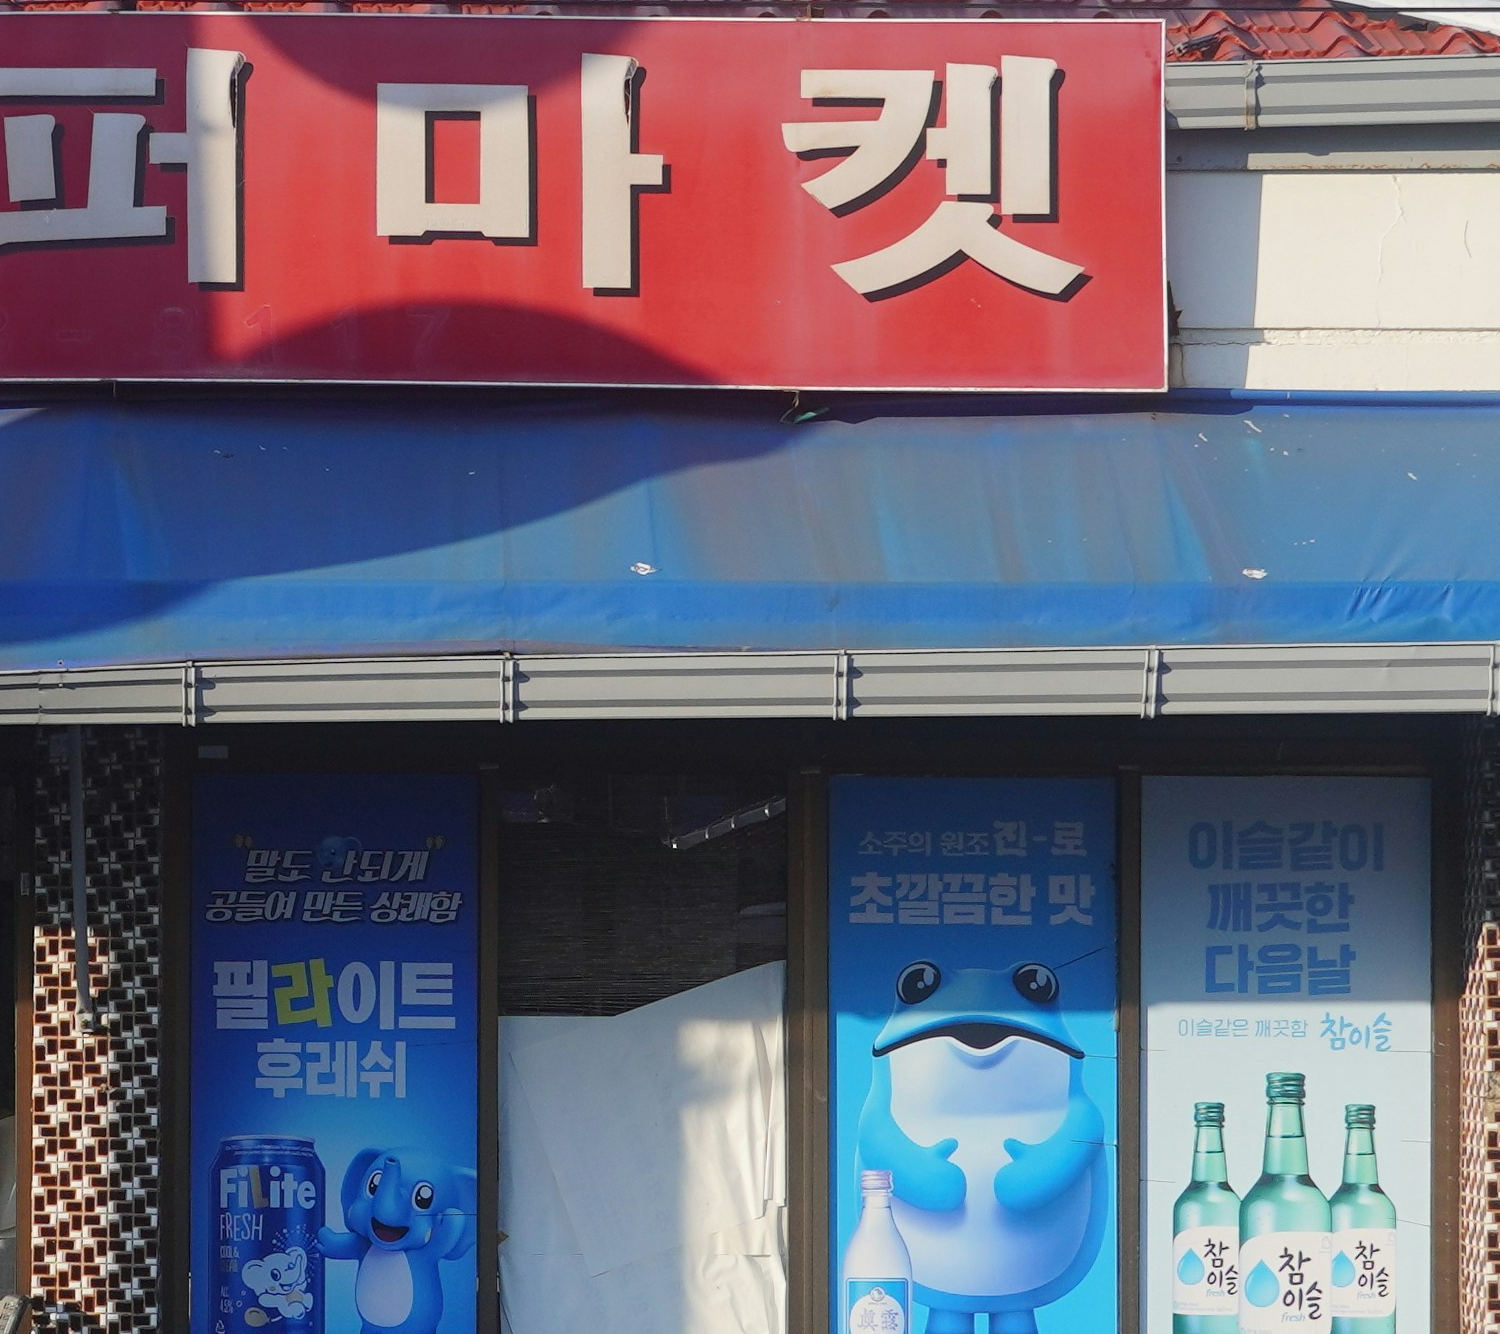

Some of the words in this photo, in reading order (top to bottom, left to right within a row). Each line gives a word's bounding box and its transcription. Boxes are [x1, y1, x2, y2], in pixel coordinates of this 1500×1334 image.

[858, 830, 932, 857] 소주의
[940, 831, 990, 857] 원조
[1188, 820, 1385, 872] 이슬같이
[244, 849, 313, 884] 말도
[205, 890, 298, 923] 공들여
[302, 891, 364, 923] 만든
[369, 890, 463, 924] 상쾌함
[849, 871, 1037, 926] 초깔끔한
[1048, 873, 1097, 927] 맛
[1206, 881, 1356, 934] 깨끗한
[1205, 943, 1357, 996] 다음날
[213, 958, 456, 1030] 필라이트
[1178, 1018, 1249, 1038] 이슬같은
[1255, 1018, 1309, 1038] 깨끗함
[1320, 1011, 1393, 1052] 참이슬
[255, 1038, 407, 1099] 후레쉬
[219, 1165, 317, 1210] FiLite
[219, 1213, 264, 1242] FRESH
[1281, 1312, 1306, 1324] fresh
